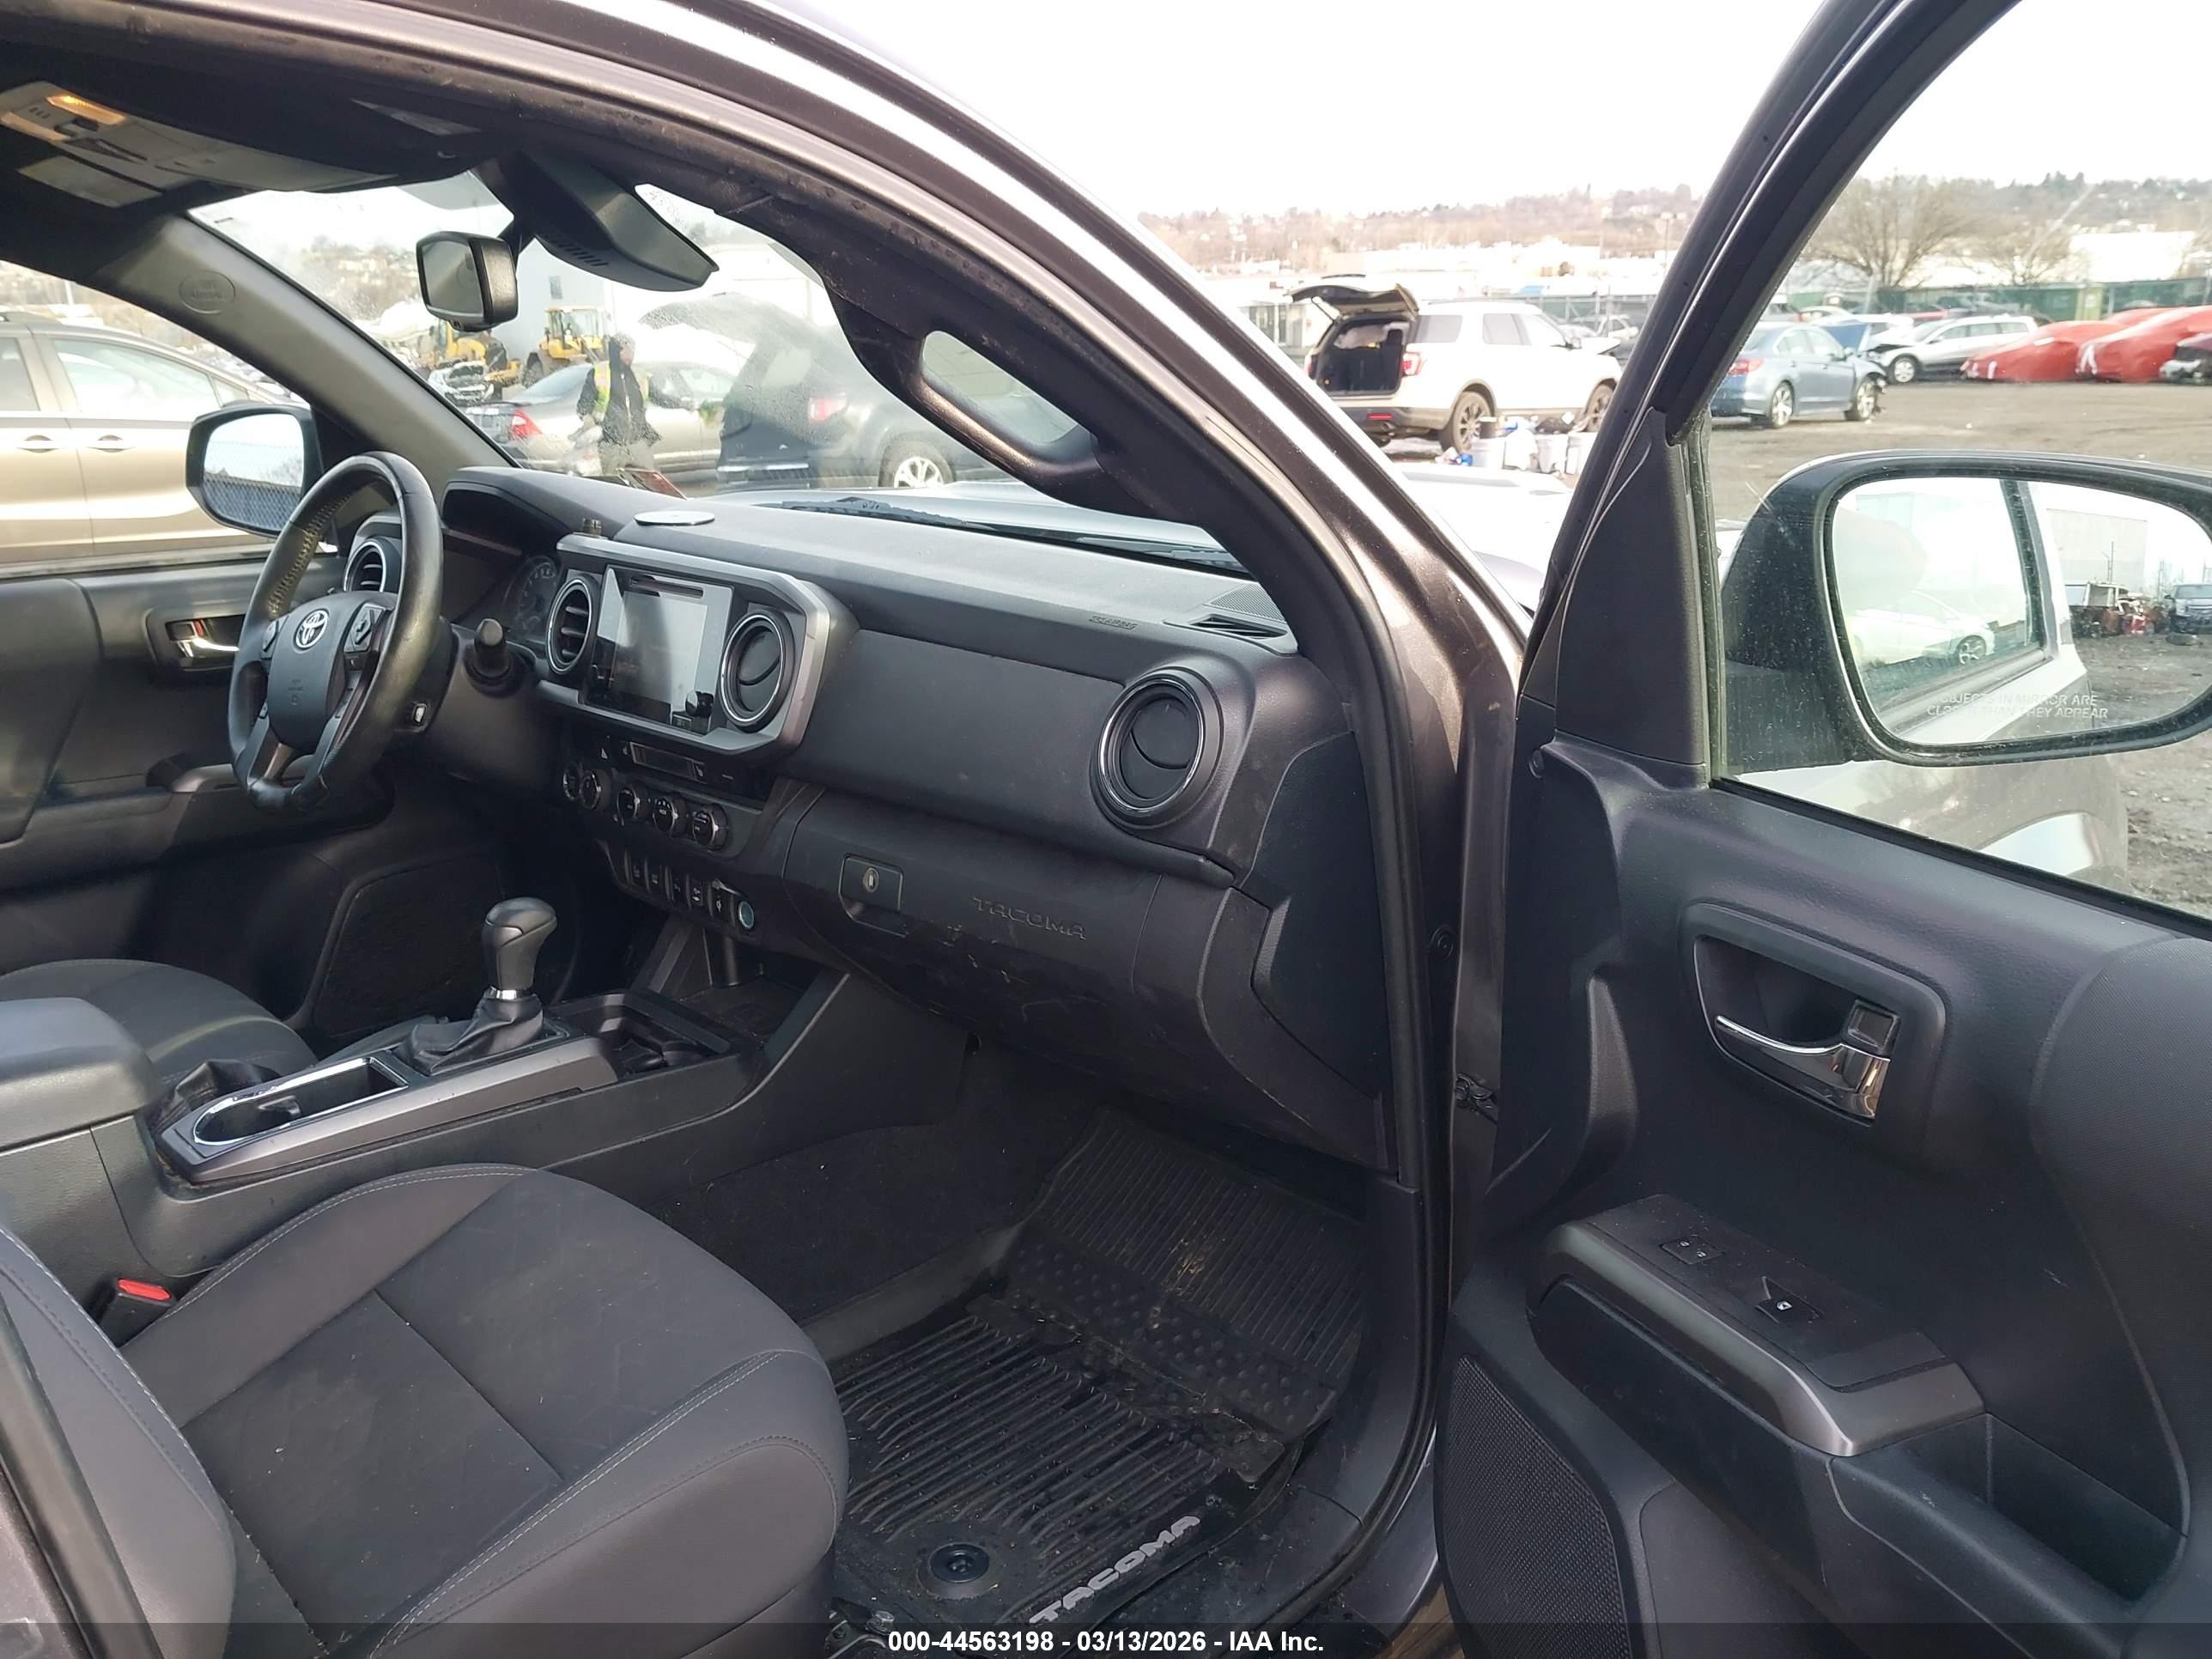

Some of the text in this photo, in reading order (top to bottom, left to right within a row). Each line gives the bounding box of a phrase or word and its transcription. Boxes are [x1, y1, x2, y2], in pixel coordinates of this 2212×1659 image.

[1927, 705, 1976, 716] CLOSR
[2054, 708, 2109, 719] APPEAR
[2071, 695, 2098, 706] ARE
[973, 896, 1086, 940] TACOMA
[1029, 1516, 1201, 1624] TACOMA
